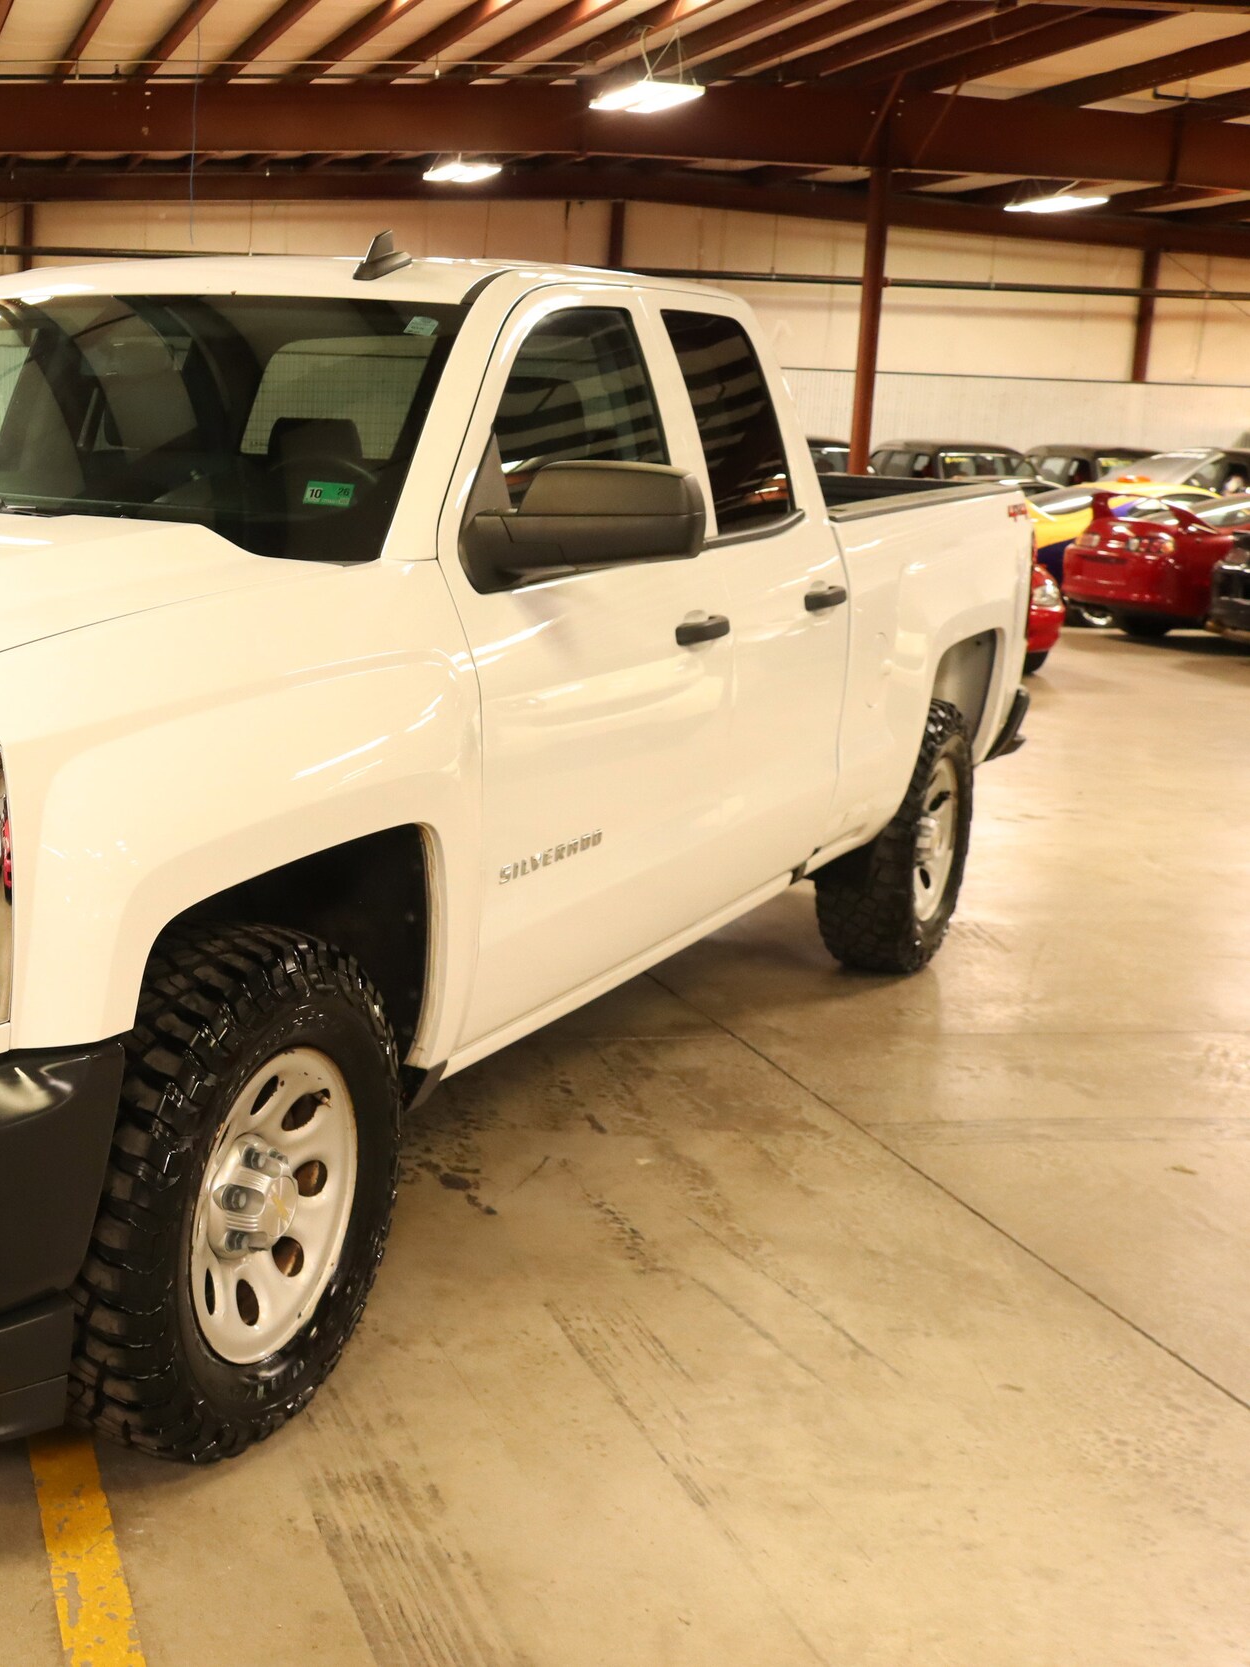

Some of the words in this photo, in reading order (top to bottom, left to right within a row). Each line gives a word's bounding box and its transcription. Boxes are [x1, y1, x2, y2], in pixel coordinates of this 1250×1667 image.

[310, 488, 323, 499] 10
[336, 487, 350, 496] 26
[499, 828, 603, 885] SILVERADO
